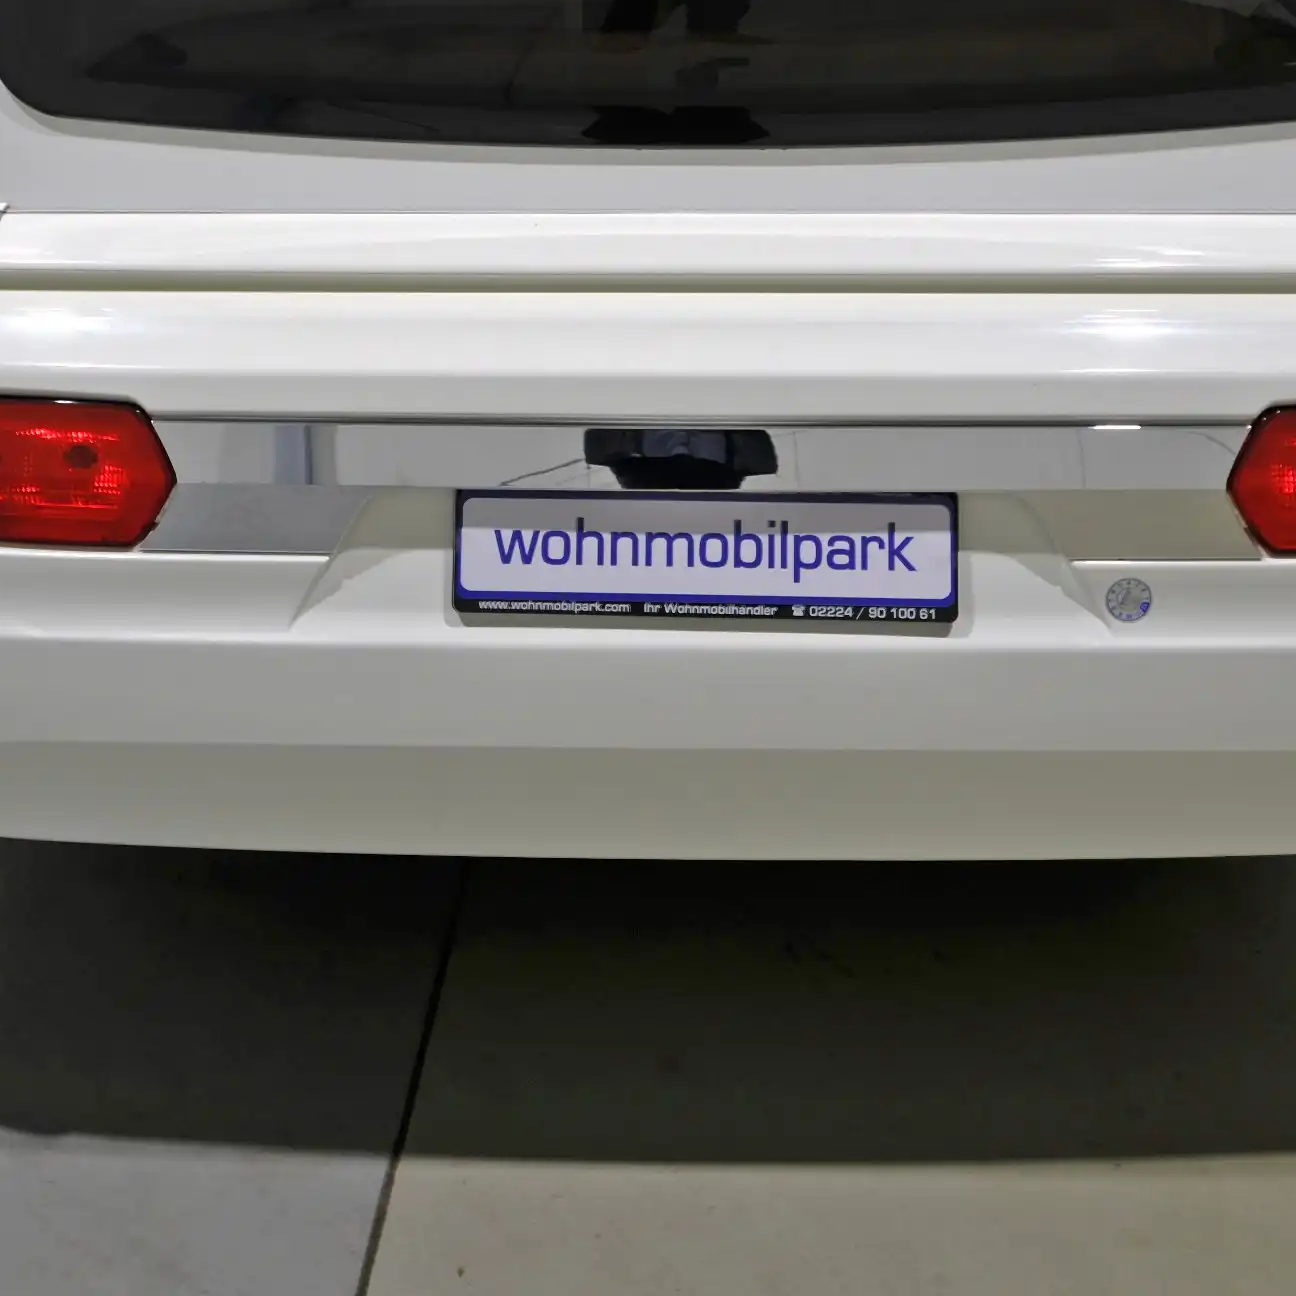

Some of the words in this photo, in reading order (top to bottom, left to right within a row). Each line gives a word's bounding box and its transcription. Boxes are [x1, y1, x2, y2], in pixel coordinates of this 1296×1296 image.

[494, 516, 917, 584] wohnmobilpark
[478, 600, 630, 613] www.wohnmobilpark.com
[643, 602, 661, 613] Ihr
[809, 605, 853, 618] 02224
[868, 607, 886, 619] 90
[890, 607, 916, 619] 100
[919, 608, 936, 620] 61
